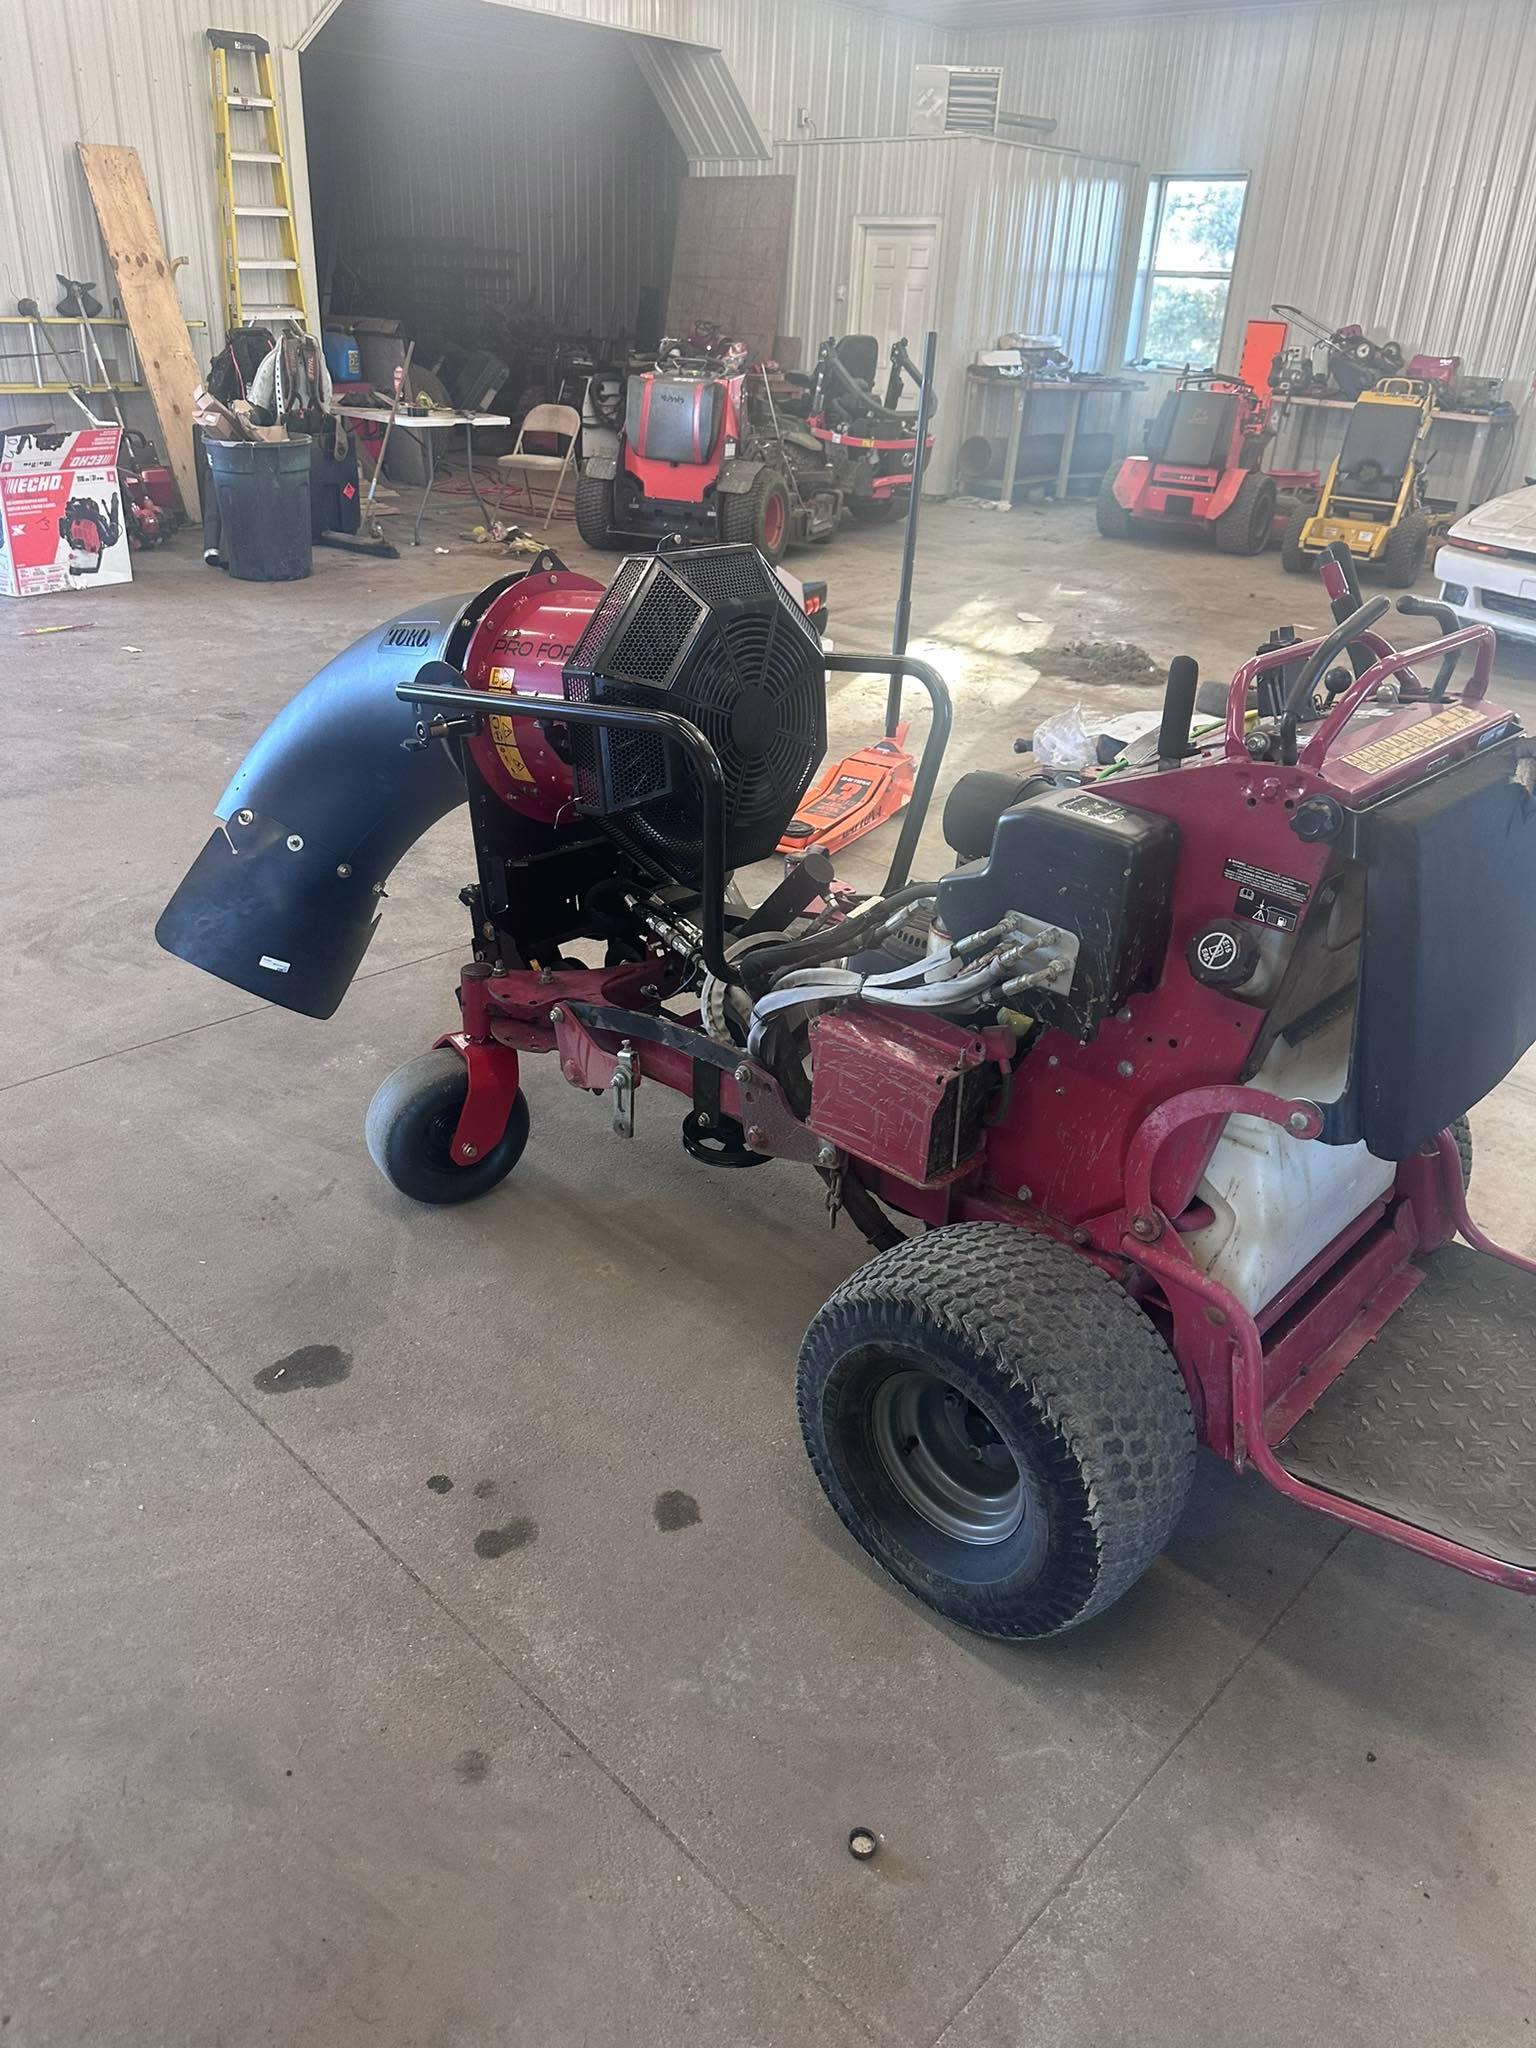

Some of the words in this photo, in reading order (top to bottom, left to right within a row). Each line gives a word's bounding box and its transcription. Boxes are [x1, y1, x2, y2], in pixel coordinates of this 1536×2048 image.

[71, 455, 105, 468] ECHO
[17, 474, 63, 494] ECHO
[492, 639, 534, 657] PRO
[1223, 939, 1233, 953] E15
[1201, 947, 1211, 962] E85
